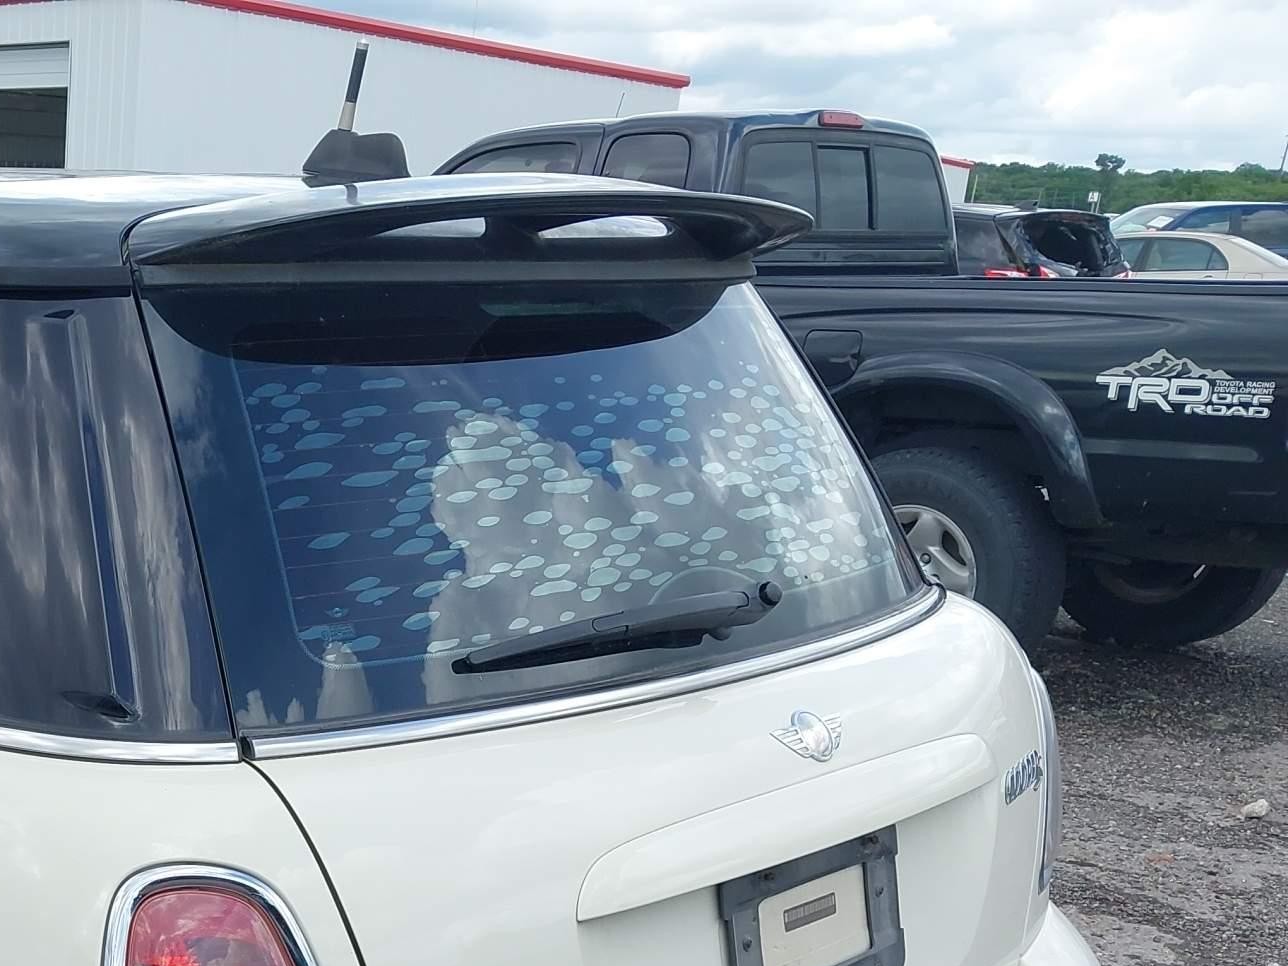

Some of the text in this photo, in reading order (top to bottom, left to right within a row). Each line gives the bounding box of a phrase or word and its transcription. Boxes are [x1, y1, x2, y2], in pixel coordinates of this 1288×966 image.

[1215, 380, 1244, 388] TOYOTA
[1096, 376, 1212, 413] TRD
[1214, 385, 1275, 395] DEVELOPMENT
[1212, 394, 1274, 405] OFF
[1184, 404, 1271, 419] ROAD
